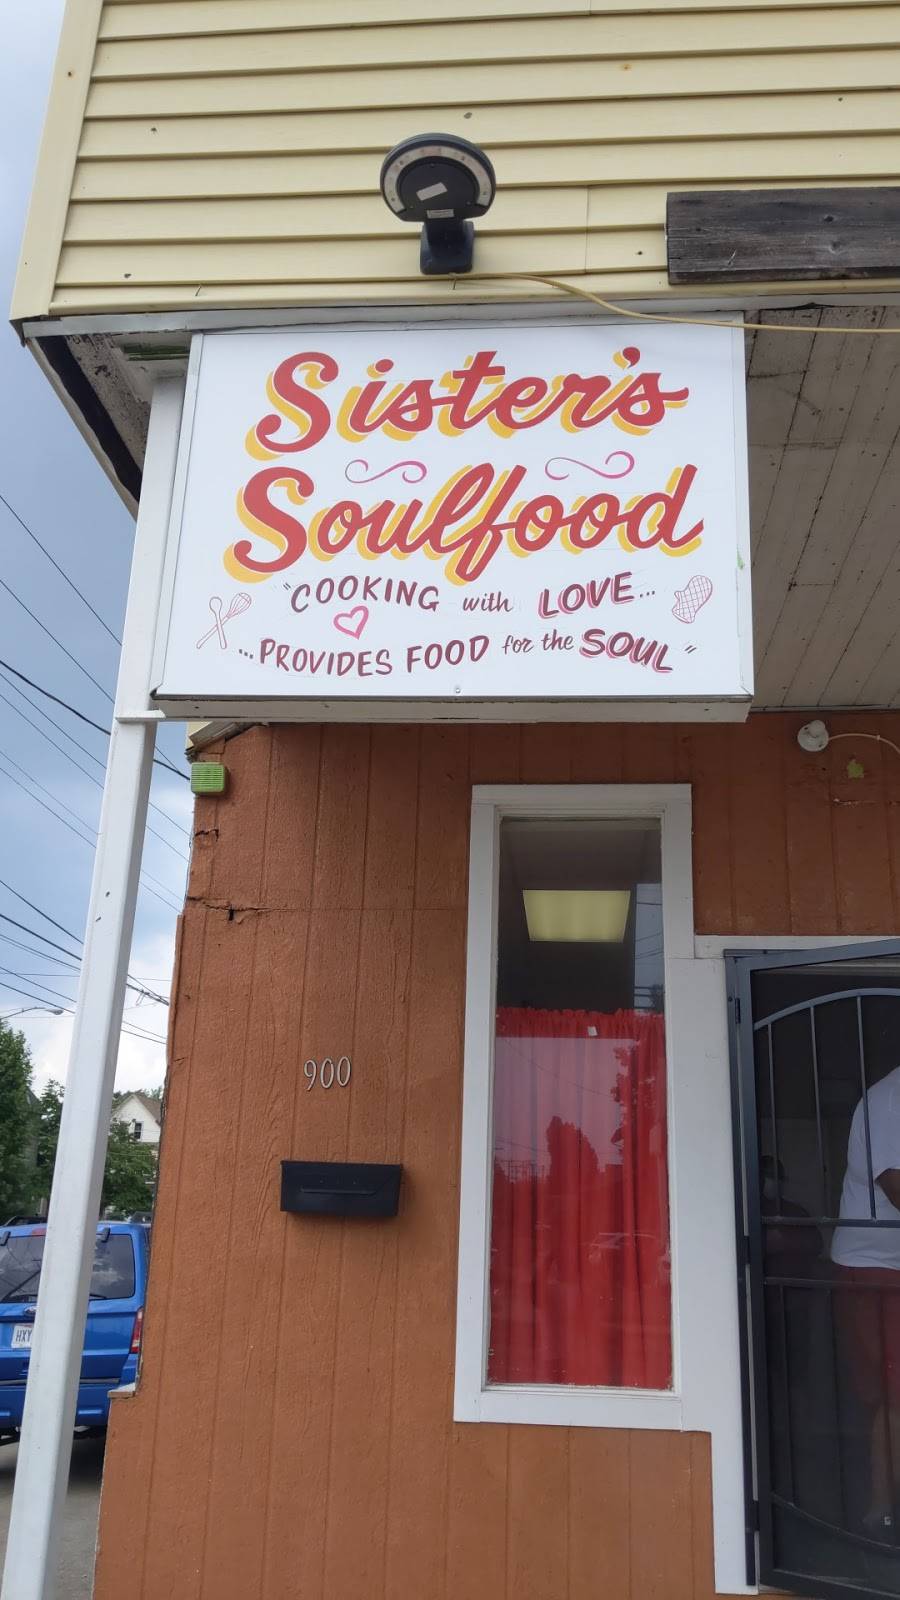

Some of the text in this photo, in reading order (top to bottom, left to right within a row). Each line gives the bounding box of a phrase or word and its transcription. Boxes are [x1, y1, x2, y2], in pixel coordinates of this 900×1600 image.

[244, 346, 689, 460] Sister's
[223, 462, 704, 586] Soulfood
[462, 591, 513, 613] with
[406, 634, 490, 673] FOOD
[502, 635, 535, 655] for
[541, 629, 575, 651] the
[304, 1056, 351, 1091] 900
